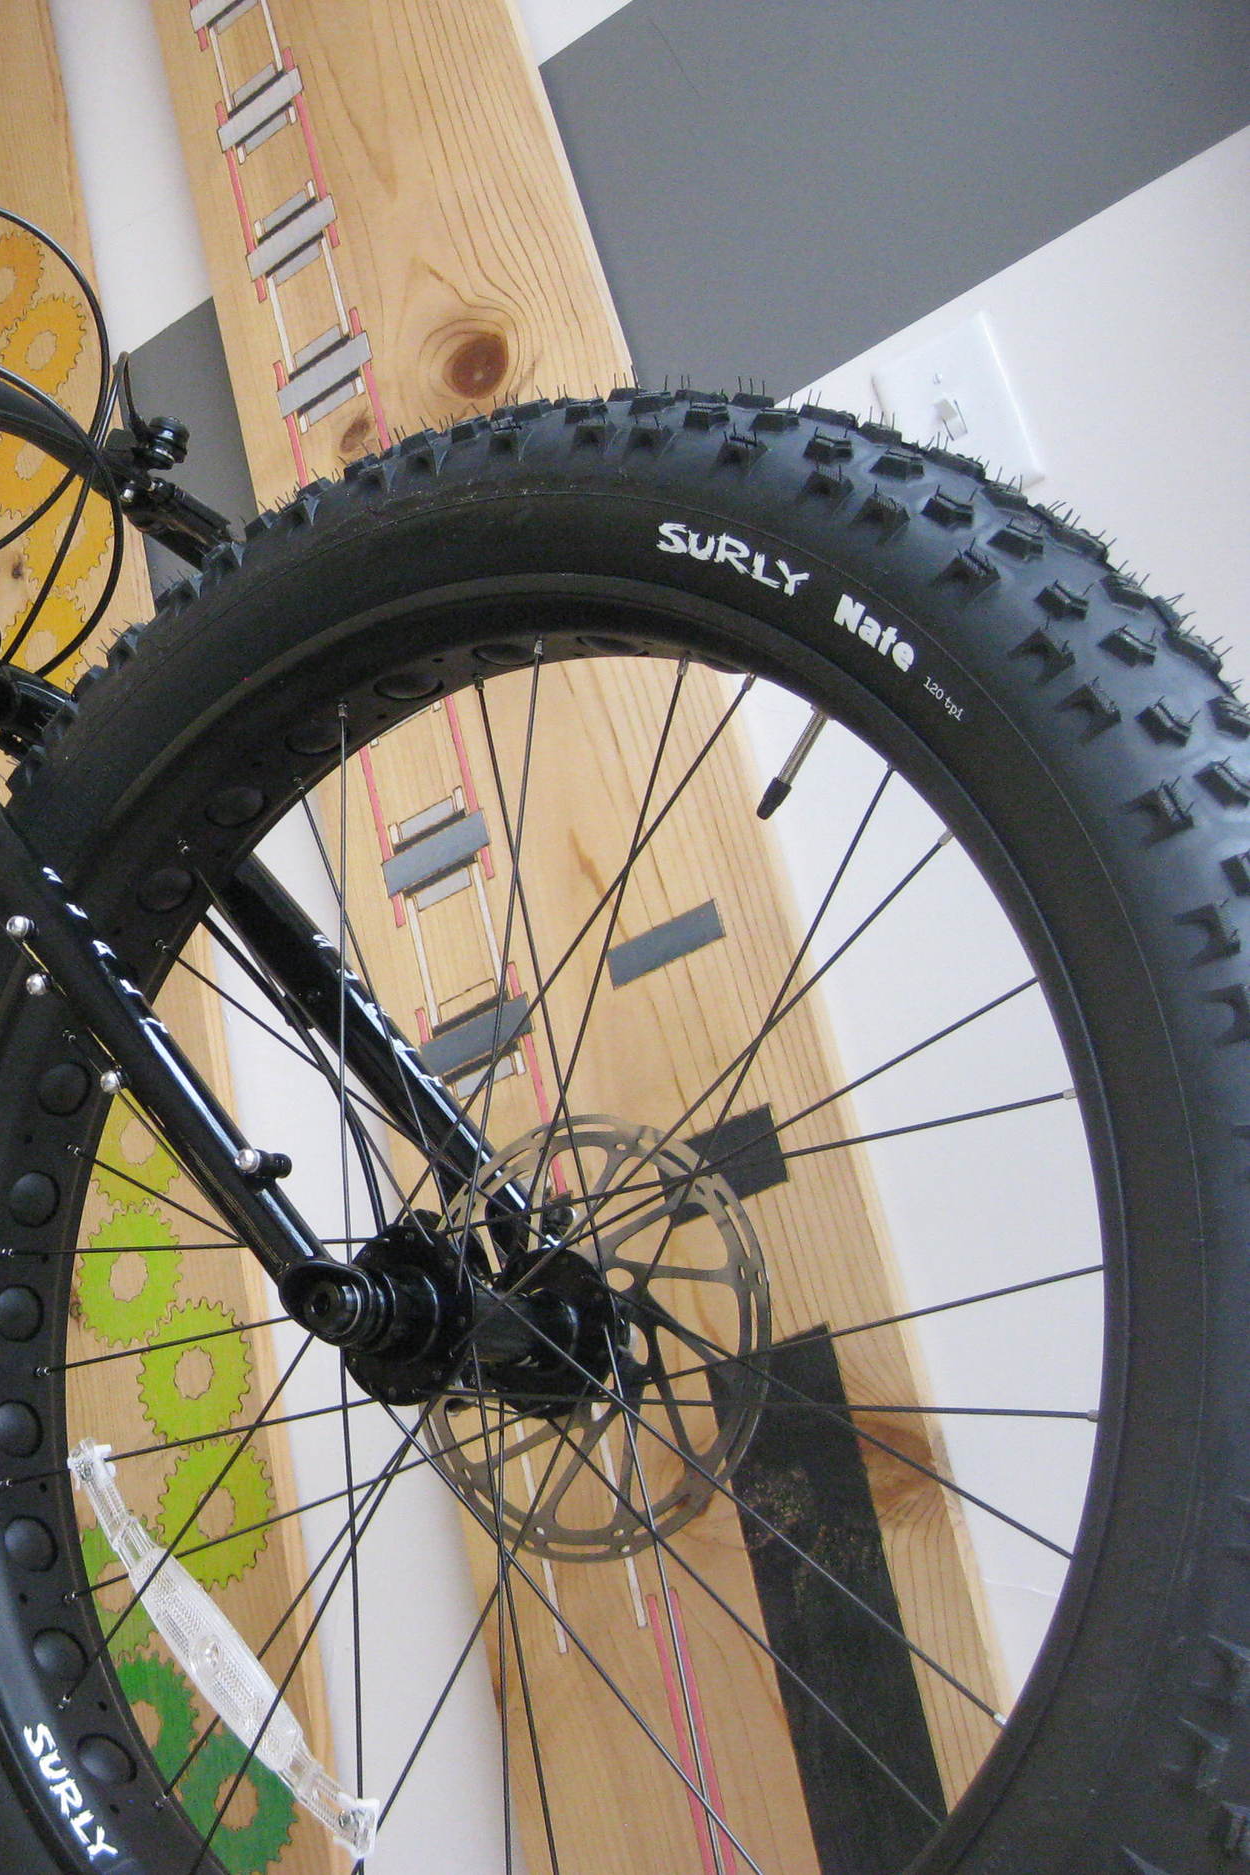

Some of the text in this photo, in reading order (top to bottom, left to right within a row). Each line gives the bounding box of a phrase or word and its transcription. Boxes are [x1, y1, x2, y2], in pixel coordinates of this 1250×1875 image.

[656, 522, 810, 597] SURLY
[833, 593, 915, 673] Nate
[23, 1723, 119, 1862] SURLY
